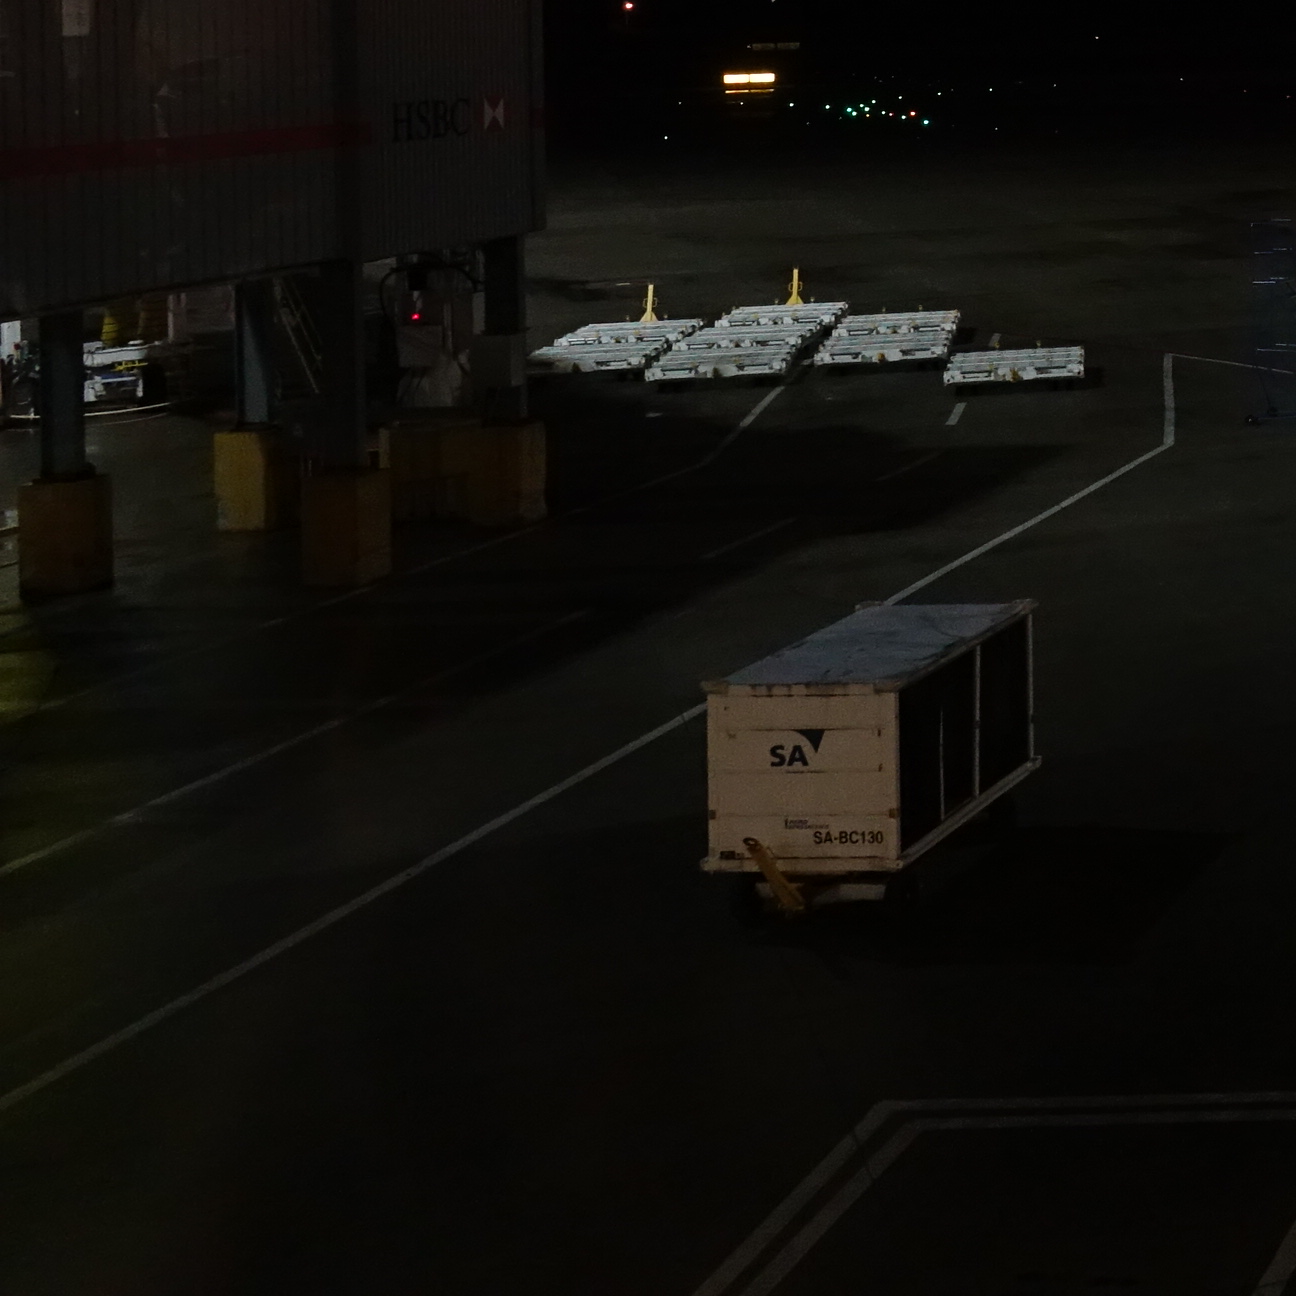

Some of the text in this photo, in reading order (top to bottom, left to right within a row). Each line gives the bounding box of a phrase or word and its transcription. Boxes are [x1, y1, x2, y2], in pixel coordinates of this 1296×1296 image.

[391, 98, 471, 142] HSBC
[769, 744, 809, 767] SA
[813, 830, 884, 844] SA-BC130
